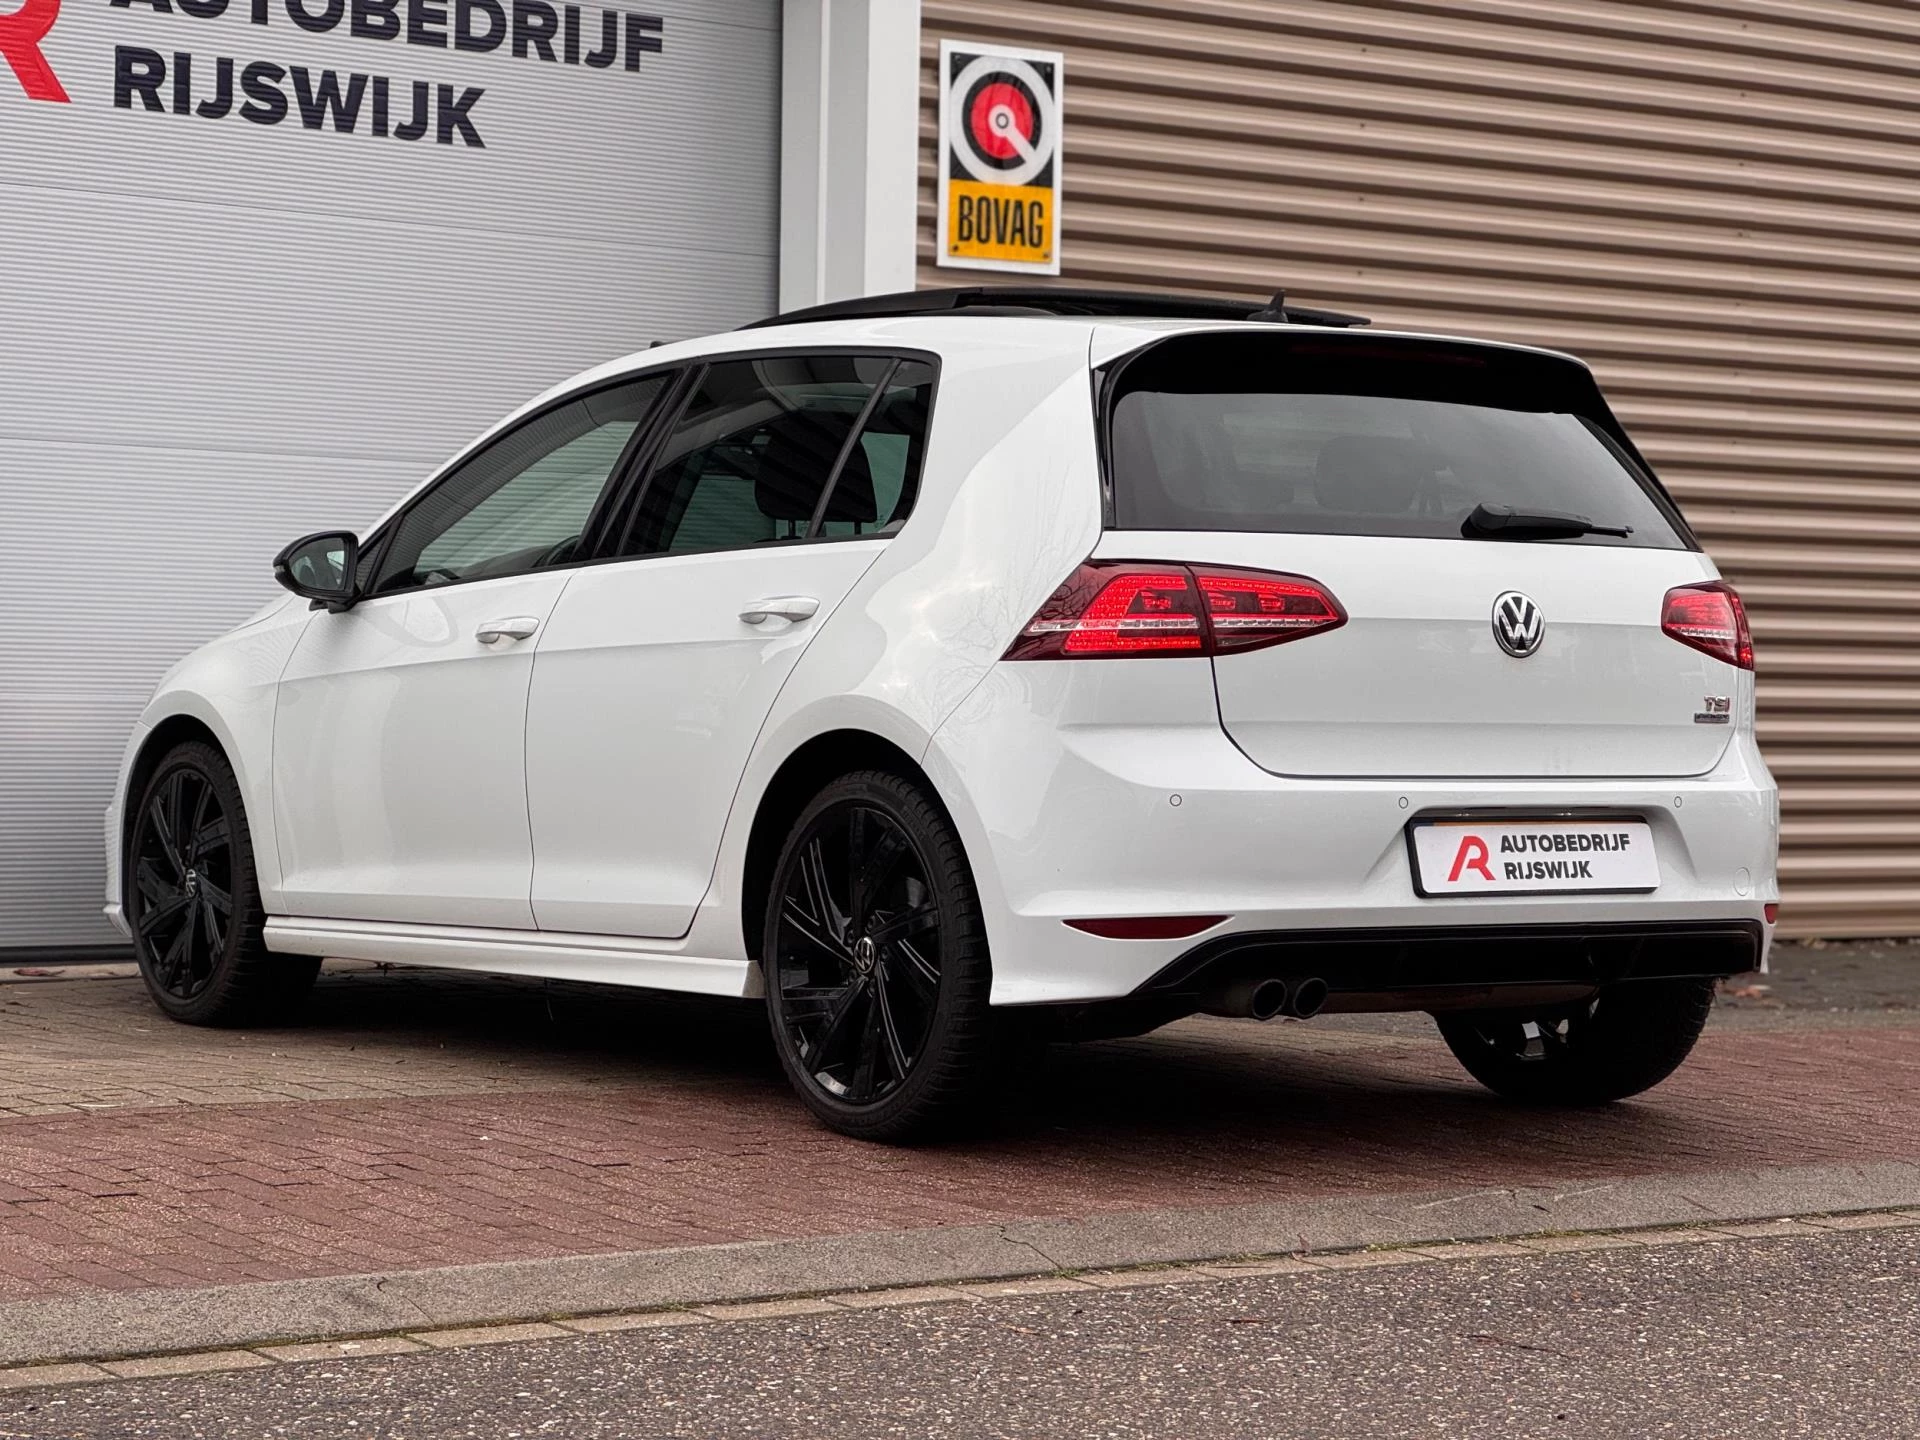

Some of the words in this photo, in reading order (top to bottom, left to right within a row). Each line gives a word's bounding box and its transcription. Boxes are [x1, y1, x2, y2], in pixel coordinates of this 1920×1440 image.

[109, 0, 663, 72] OBEDRIJF
[114, 45, 486, 149] RIJSWIJK
[958, 195, 1043, 248] BOVAG
[1500, 833, 1630, 853] AUTOBEDRIJF
[1503, 860, 1593, 880] RIJSWIJK
